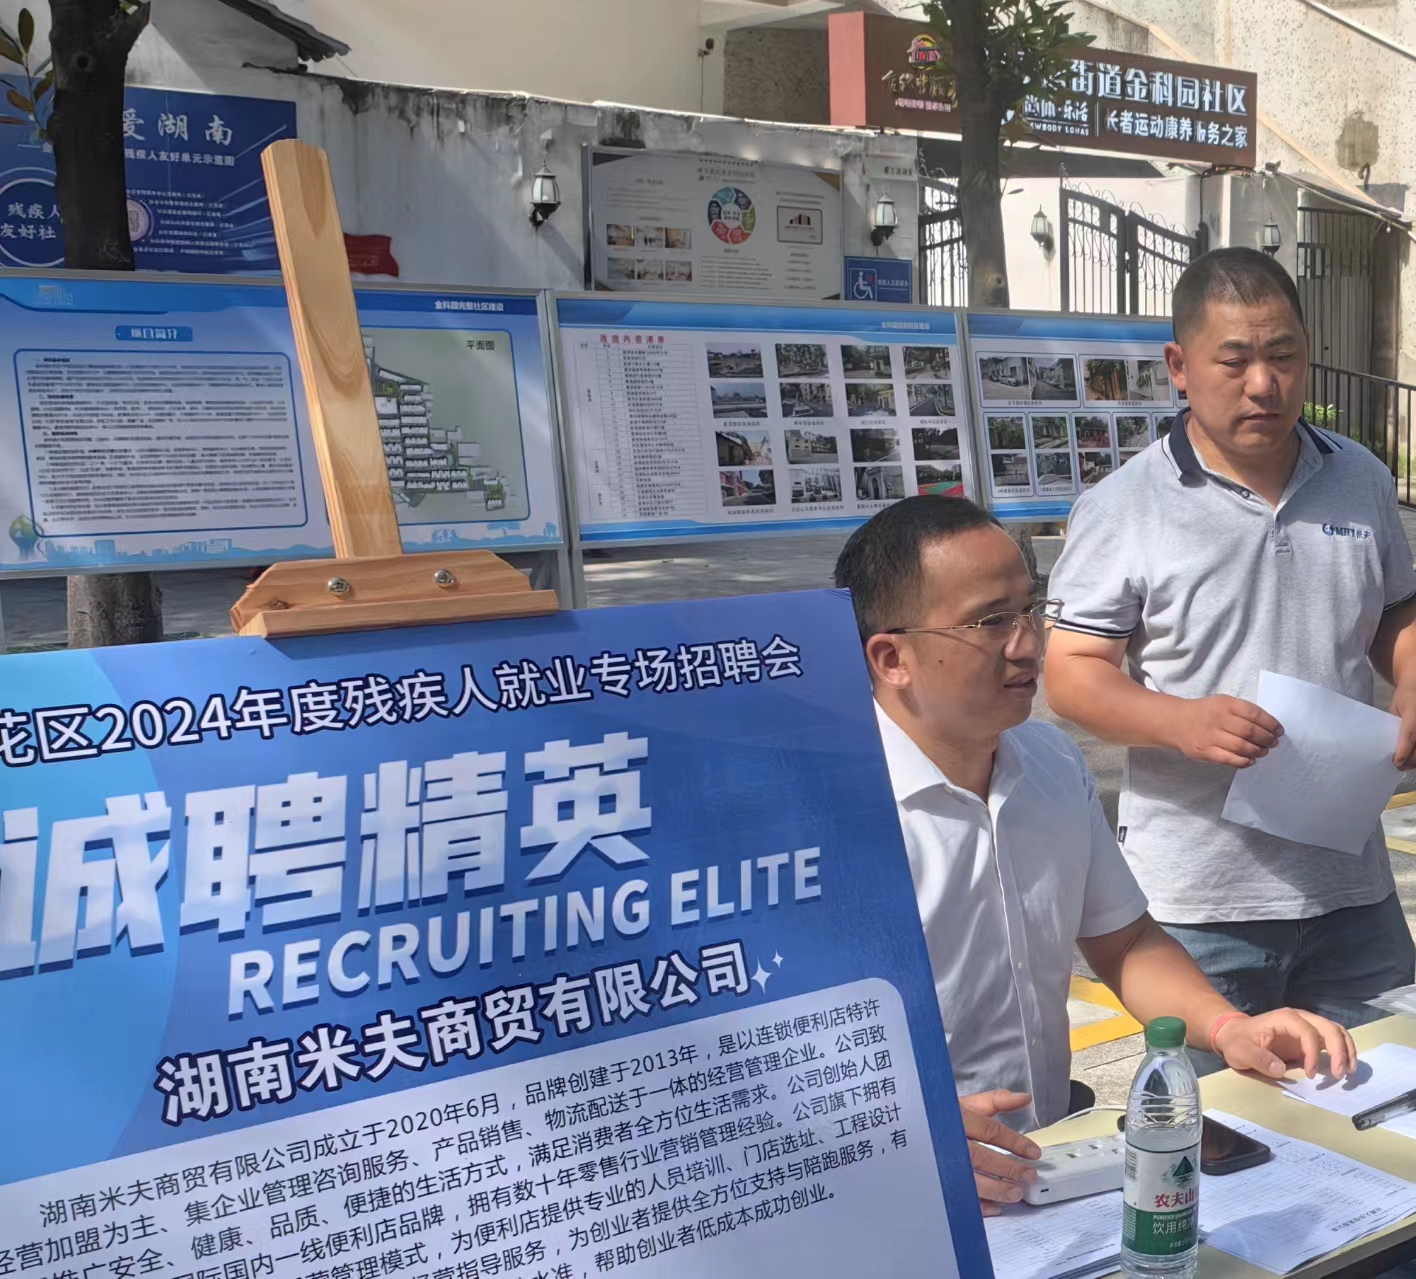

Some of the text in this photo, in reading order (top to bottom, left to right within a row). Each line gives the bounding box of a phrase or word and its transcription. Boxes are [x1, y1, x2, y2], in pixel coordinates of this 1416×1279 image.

[0, 636, 802, 765] 花区2024年度残疾人就业专场招聘会
[0, 731, 652, 978] 诚聘精英
[229, 846, 822, 1016] RECRUITING ELITE
[157, 941, 750, 1124] 湖南米夫商贸有限公司
